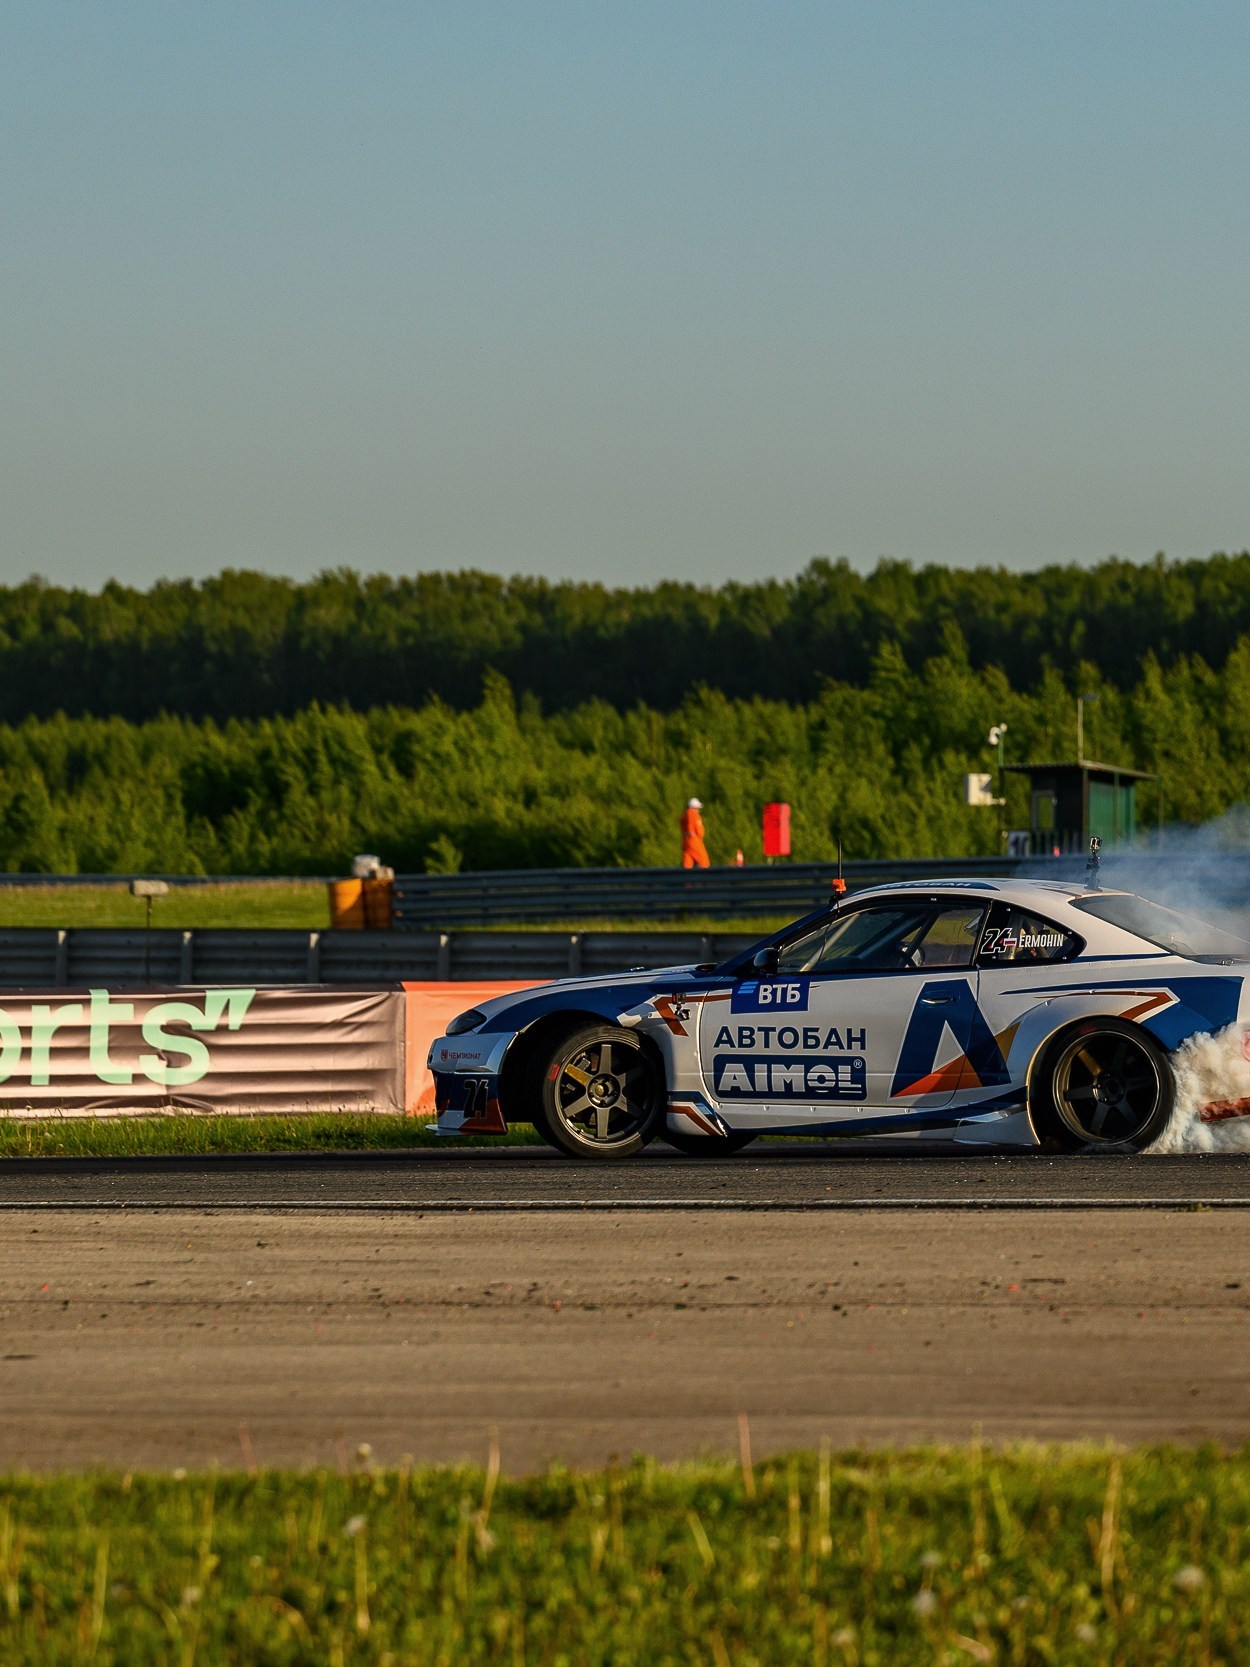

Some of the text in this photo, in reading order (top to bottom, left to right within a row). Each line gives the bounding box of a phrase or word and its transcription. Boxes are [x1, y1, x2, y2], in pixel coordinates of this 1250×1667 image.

[1019, 934, 1064, 948] ERMOHIN
[758, 984, 800, 1004] ВТБ
[713, 1026, 866, 1050] АВТОБАН
[464, 1079, 488, 1119] 24
